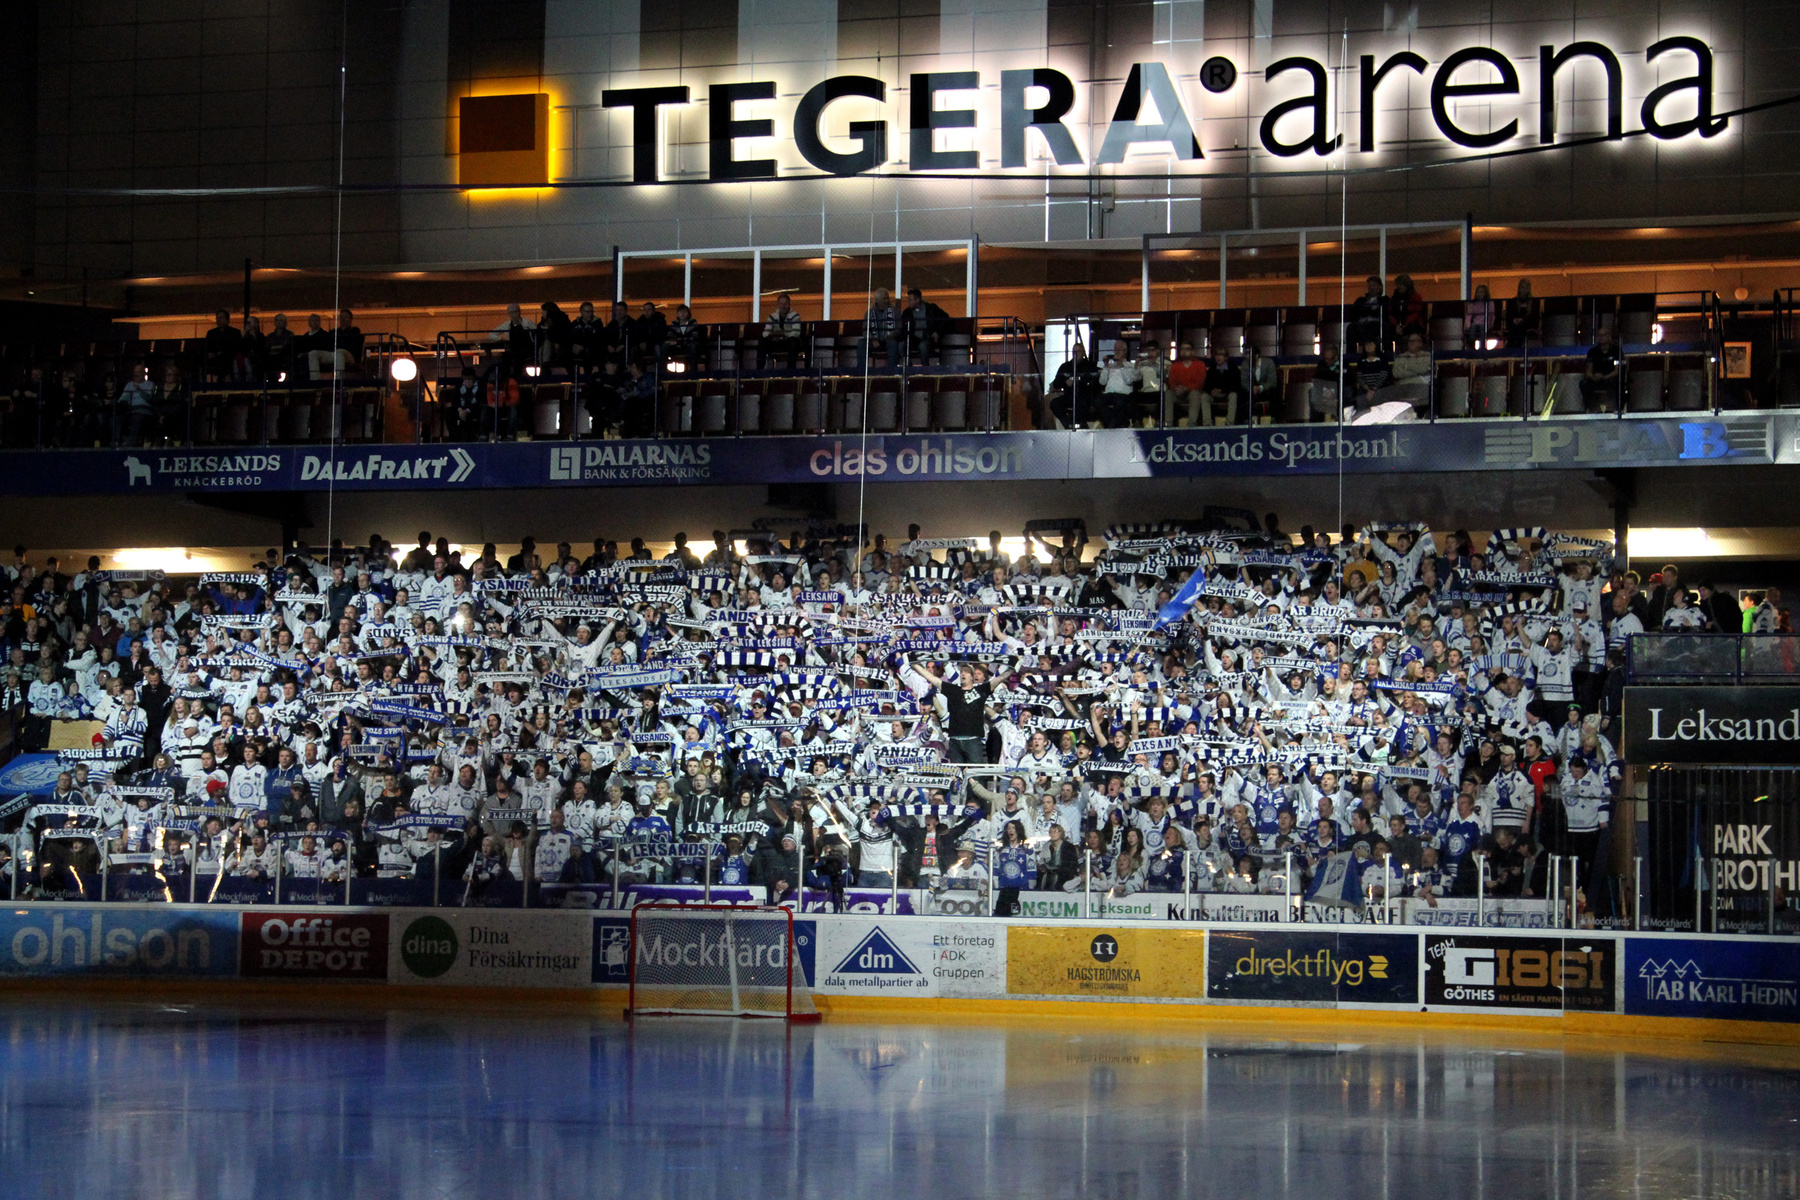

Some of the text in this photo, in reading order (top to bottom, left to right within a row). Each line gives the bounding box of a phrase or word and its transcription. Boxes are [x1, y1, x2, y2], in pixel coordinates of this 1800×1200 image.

[1261, 34, 1728, 157] arena
[1128, 430, 1409, 468] Leksands Sparbank
[1527, 422, 1729, 463] PEAB
[158, 455, 281, 473] LEKSANDS
[585, 444, 711, 467] DALARNAS
[809, 439, 1024, 476] clas ohlson
[174, 475, 262, 487] KNÄCKEBRÖD
[584, 466, 710, 480] BANK & FÖRSÄKRING
[1526, 575, 1547, 584] LAG
[801, 591, 839, 601] LEKSAND
[757, 637, 792, 648] LEKSING
[602, 673, 669, 687] LEKSANDS IF
[1377, 680, 1453, 692] DALARNAS STOLTHET
[1648, 707, 1800, 741] Leksand
[906, 777, 950, 786] LEKSAND
[37, 804, 97, 814] PASSION
[493, 811, 533, 819] LEKSAND
[415, 816, 454, 826] STOLTHET
[1714, 823, 1773, 855] PARK
[634, 843, 707, 857] LEKSANDS
[1717, 859, 1800, 891] BROTH
[1090, 902, 1152, 915] Leksand
[11, 913, 210, 967] ohlson
[261, 919, 371, 947] Office
[469, 926, 510, 944] Dina
[933, 935, 995, 948] Ett företag
[406, 935, 451, 955] dina
[1428, 938, 1456, 960] TEAM
[261, 949, 369, 971] DEPOT
[468, 951, 580, 973] Försäkringar
[859, 947, 894, 969] dm
[933, 951, 936, 961] i
[933, 966, 985, 980] Gruppen
[1067, 965, 1141, 982] HAGSTRÖMSKA
[1236, 947, 1364, 986] direktflyg
[1496, 949, 1604, 989] 1861
[825, 976, 929, 989] dala metallpartier ab
[1444, 986, 1495, 1001] GÖTHES
[1656, 979, 1798, 1007] AB KARL HEDIN
